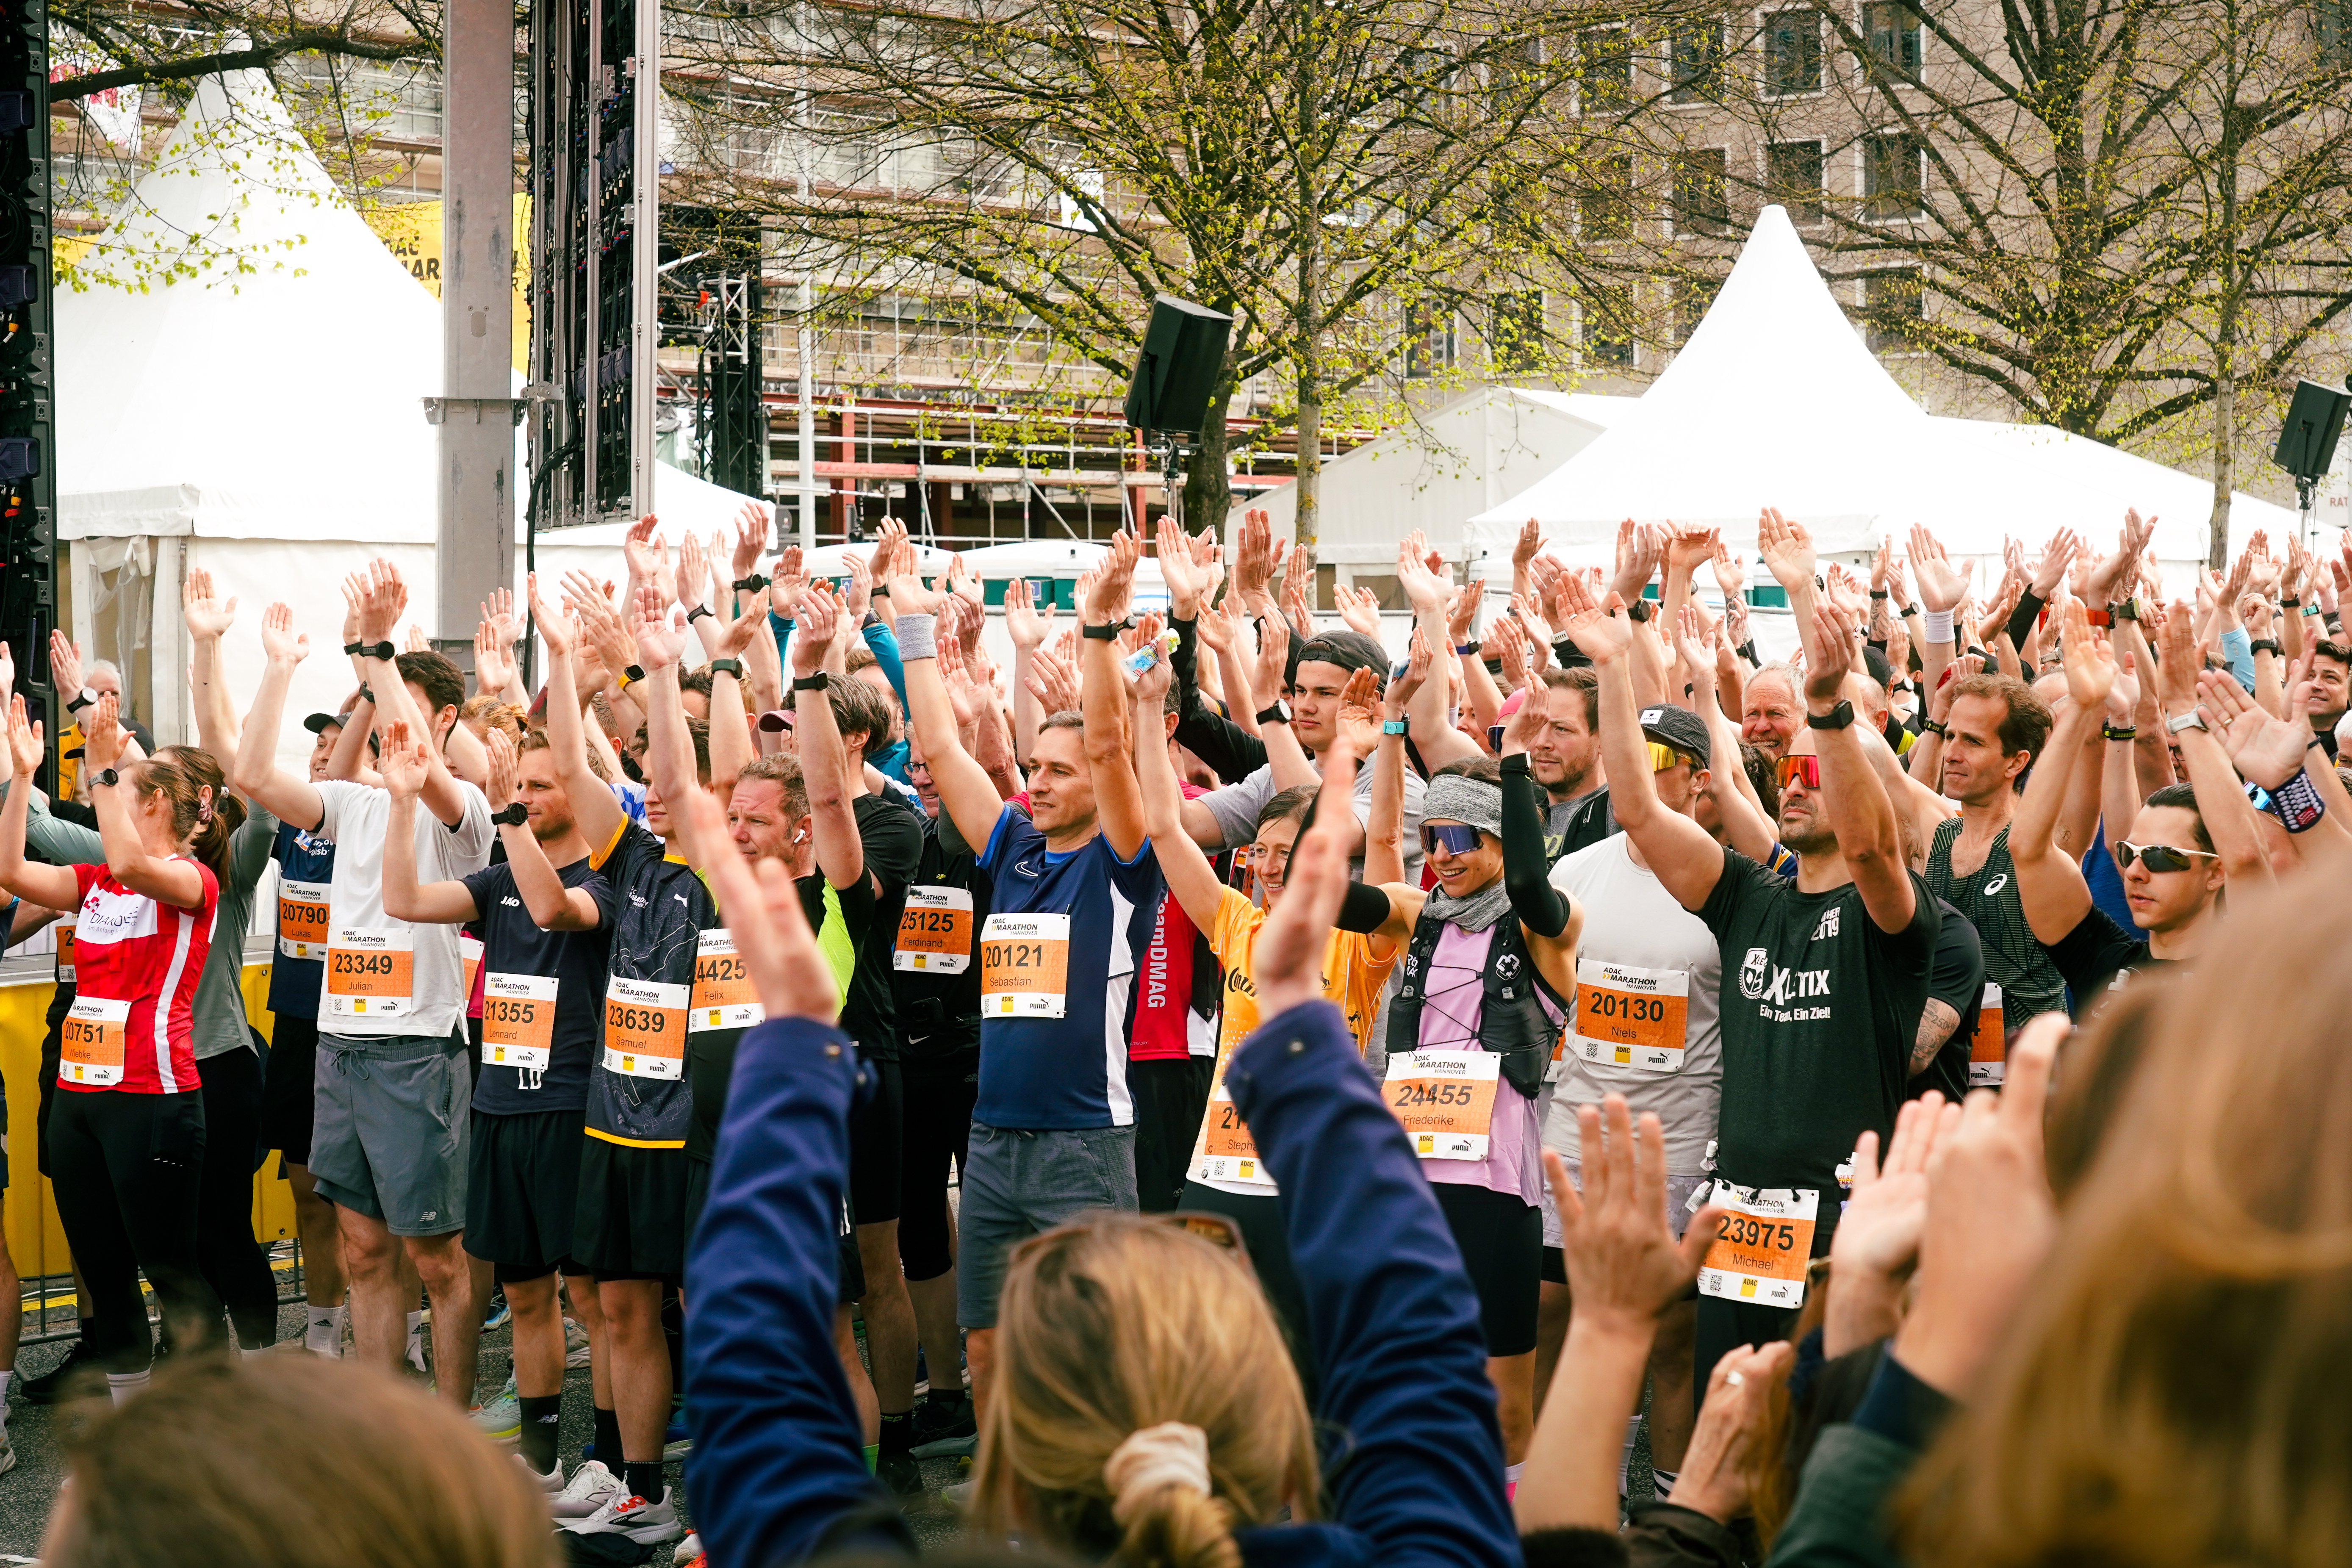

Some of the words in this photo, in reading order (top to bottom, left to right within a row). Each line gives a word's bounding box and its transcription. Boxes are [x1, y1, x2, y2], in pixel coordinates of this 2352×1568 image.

[500, 896, 520, 907] JAO
[283, 903, 327, 924] 20790
[901, 911, 953, 932] 25125
[96, 927, 114, 935] Anfang
[292, 928, 311, 937] Lukas
[1811, 917, 1839, 941] 2019
[699, 939, 735, 947] MARATHO
[904, 937, 942, 947] Ferdinand
[986, 945, 1042, 968] 20121
[335, 953, 392, 975] 23349
[349, 982, 372, 990] Julian
[990, 977, 1031, 986] Sebastian
[1610, 975, 1657, 986] MARATHON
[495, 983, 530, 991] MARATHON
[619, 988, 659, 998] MARATHON
[704, 990, 723, 1000] Felix
[485, 1000, 535, 1023] 21355
[1590, 992, 1663, 1022] 20130
[1760, 1004, 1773, 1019] Ein
[1794, 1008, 1809, 1020] Ein
[1810, 1007, 1831, 1019] Ziel!
[609, 1005, 664, 1033] 23639
[65, 1021, 103, 1043] 20751
[490, 1029, 517, 1039] Lennard
[1612, 1026, 1637, 1038] Niels
[616, 1036, 646, 1049] Samuel
[69, 1048, 91, 1059] Wiebke
[1395, 1084, 1473, 1106] 24455
[1404, 1114, 1454, 1125] Friederike
[1228, 1139, 1258, 1152] Stepha
[1740, 1197, 1784, 1208] MARATHON
[1717, 1215, 1794, 1250] 23975
[1733, 1254, 1774, 1270] Michael
[1743, 1278, 1757, 1286] ADAC
